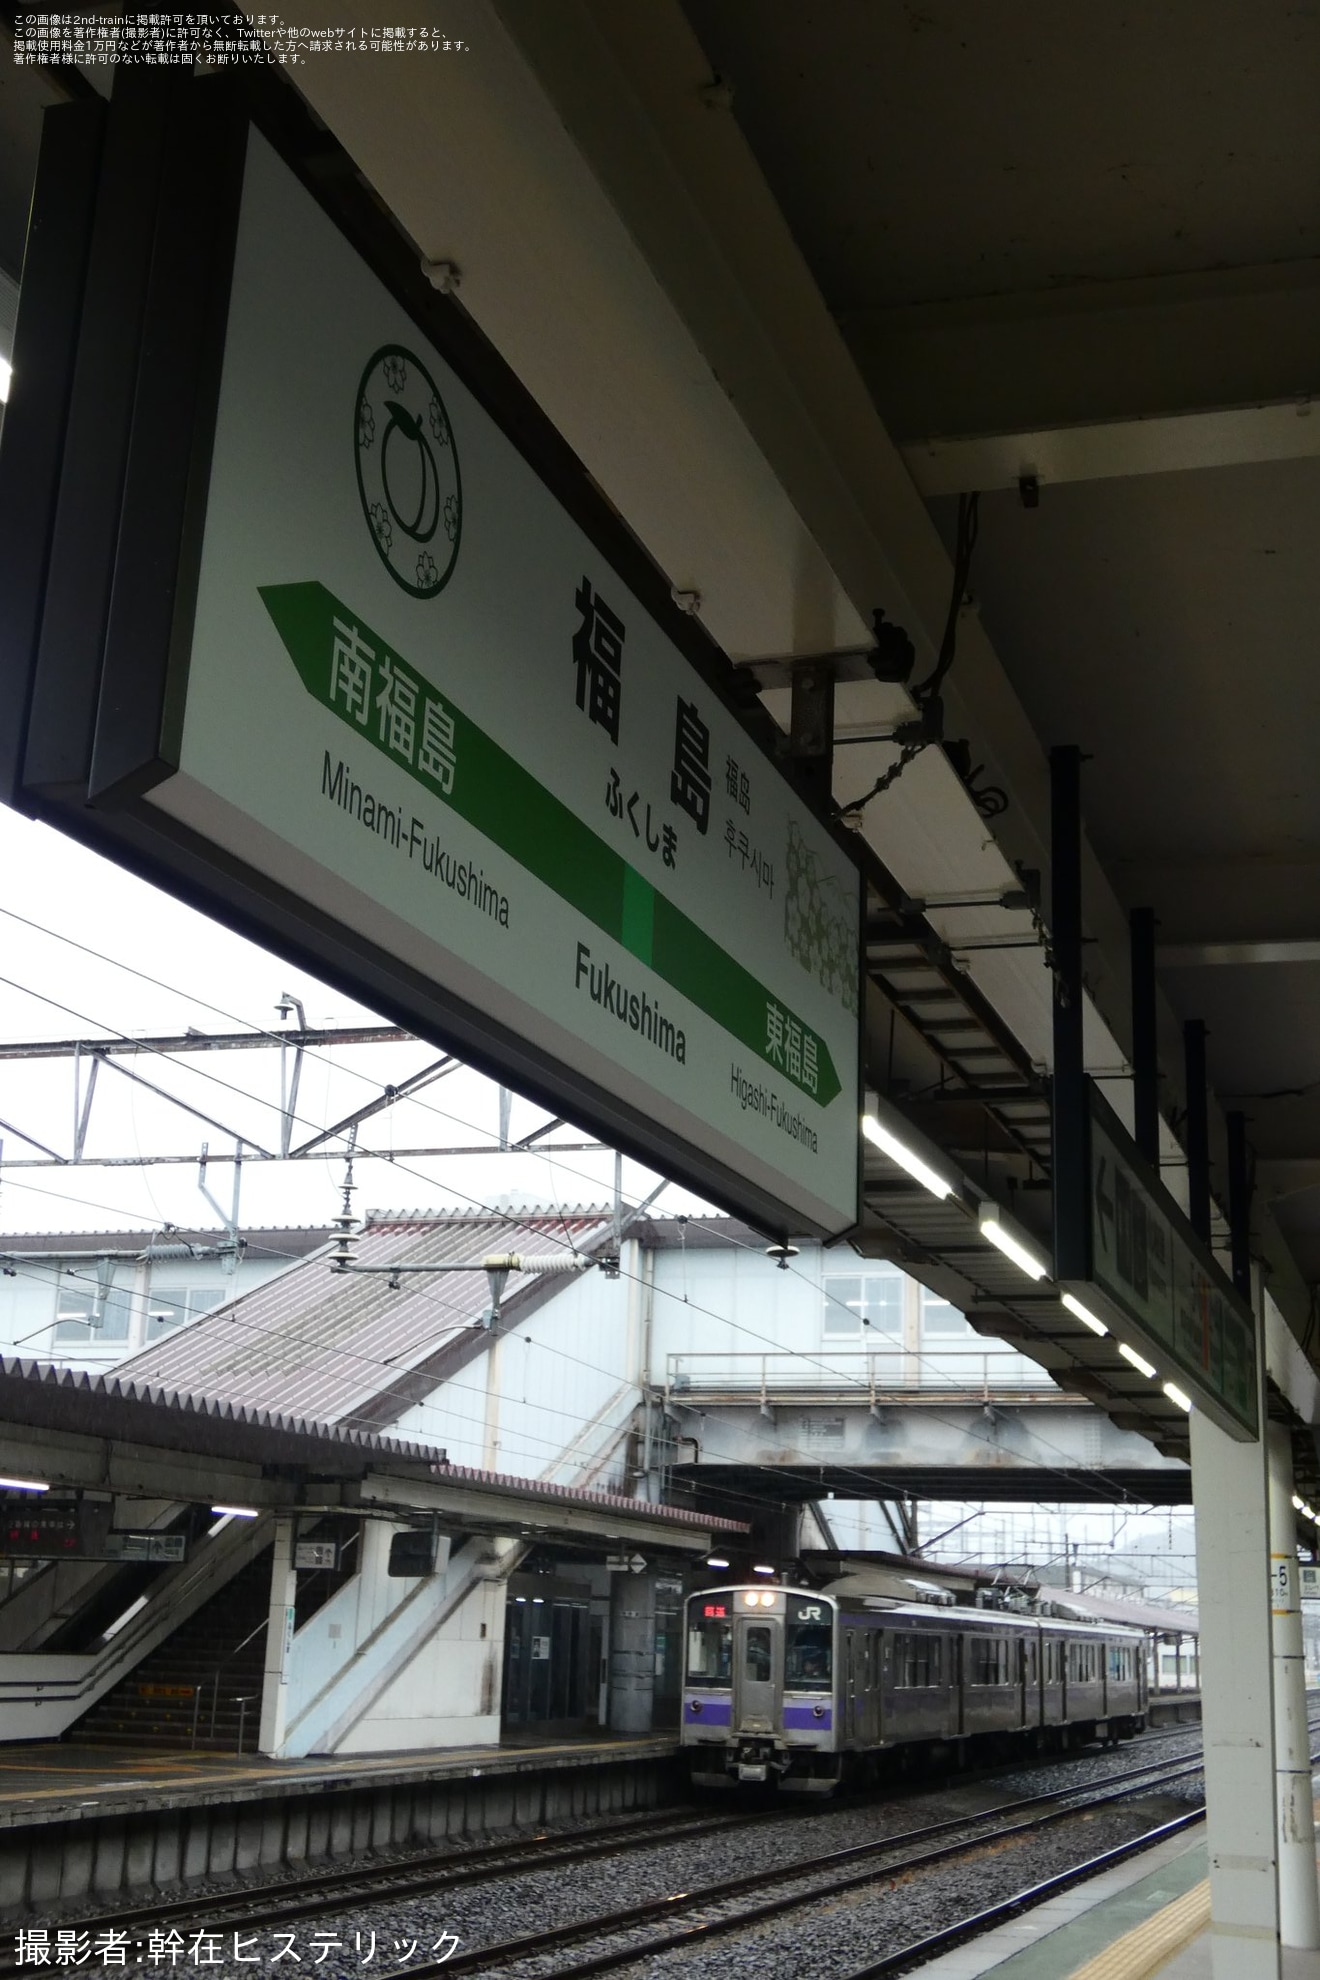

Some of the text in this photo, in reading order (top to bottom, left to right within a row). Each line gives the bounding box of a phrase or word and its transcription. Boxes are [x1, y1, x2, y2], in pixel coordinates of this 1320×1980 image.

[329, 615, 457, 795] 南福島
[572, 575, 712, 835] 福島
[605, 767, 678, 870] ふくしま
[725, 755, 750, 815] 福岛
[321, 750, 509, 929] Minami-Fukushima
[724, 819, 775, 900] 후쿠시마
[574, 940, 687, 1066] Fukushima
[764, 1000, 819, 1095] 東福島
[730, 1062, 819, 1154] Higashi-Fukushima
[797, 1606, 822, 1621] JR
